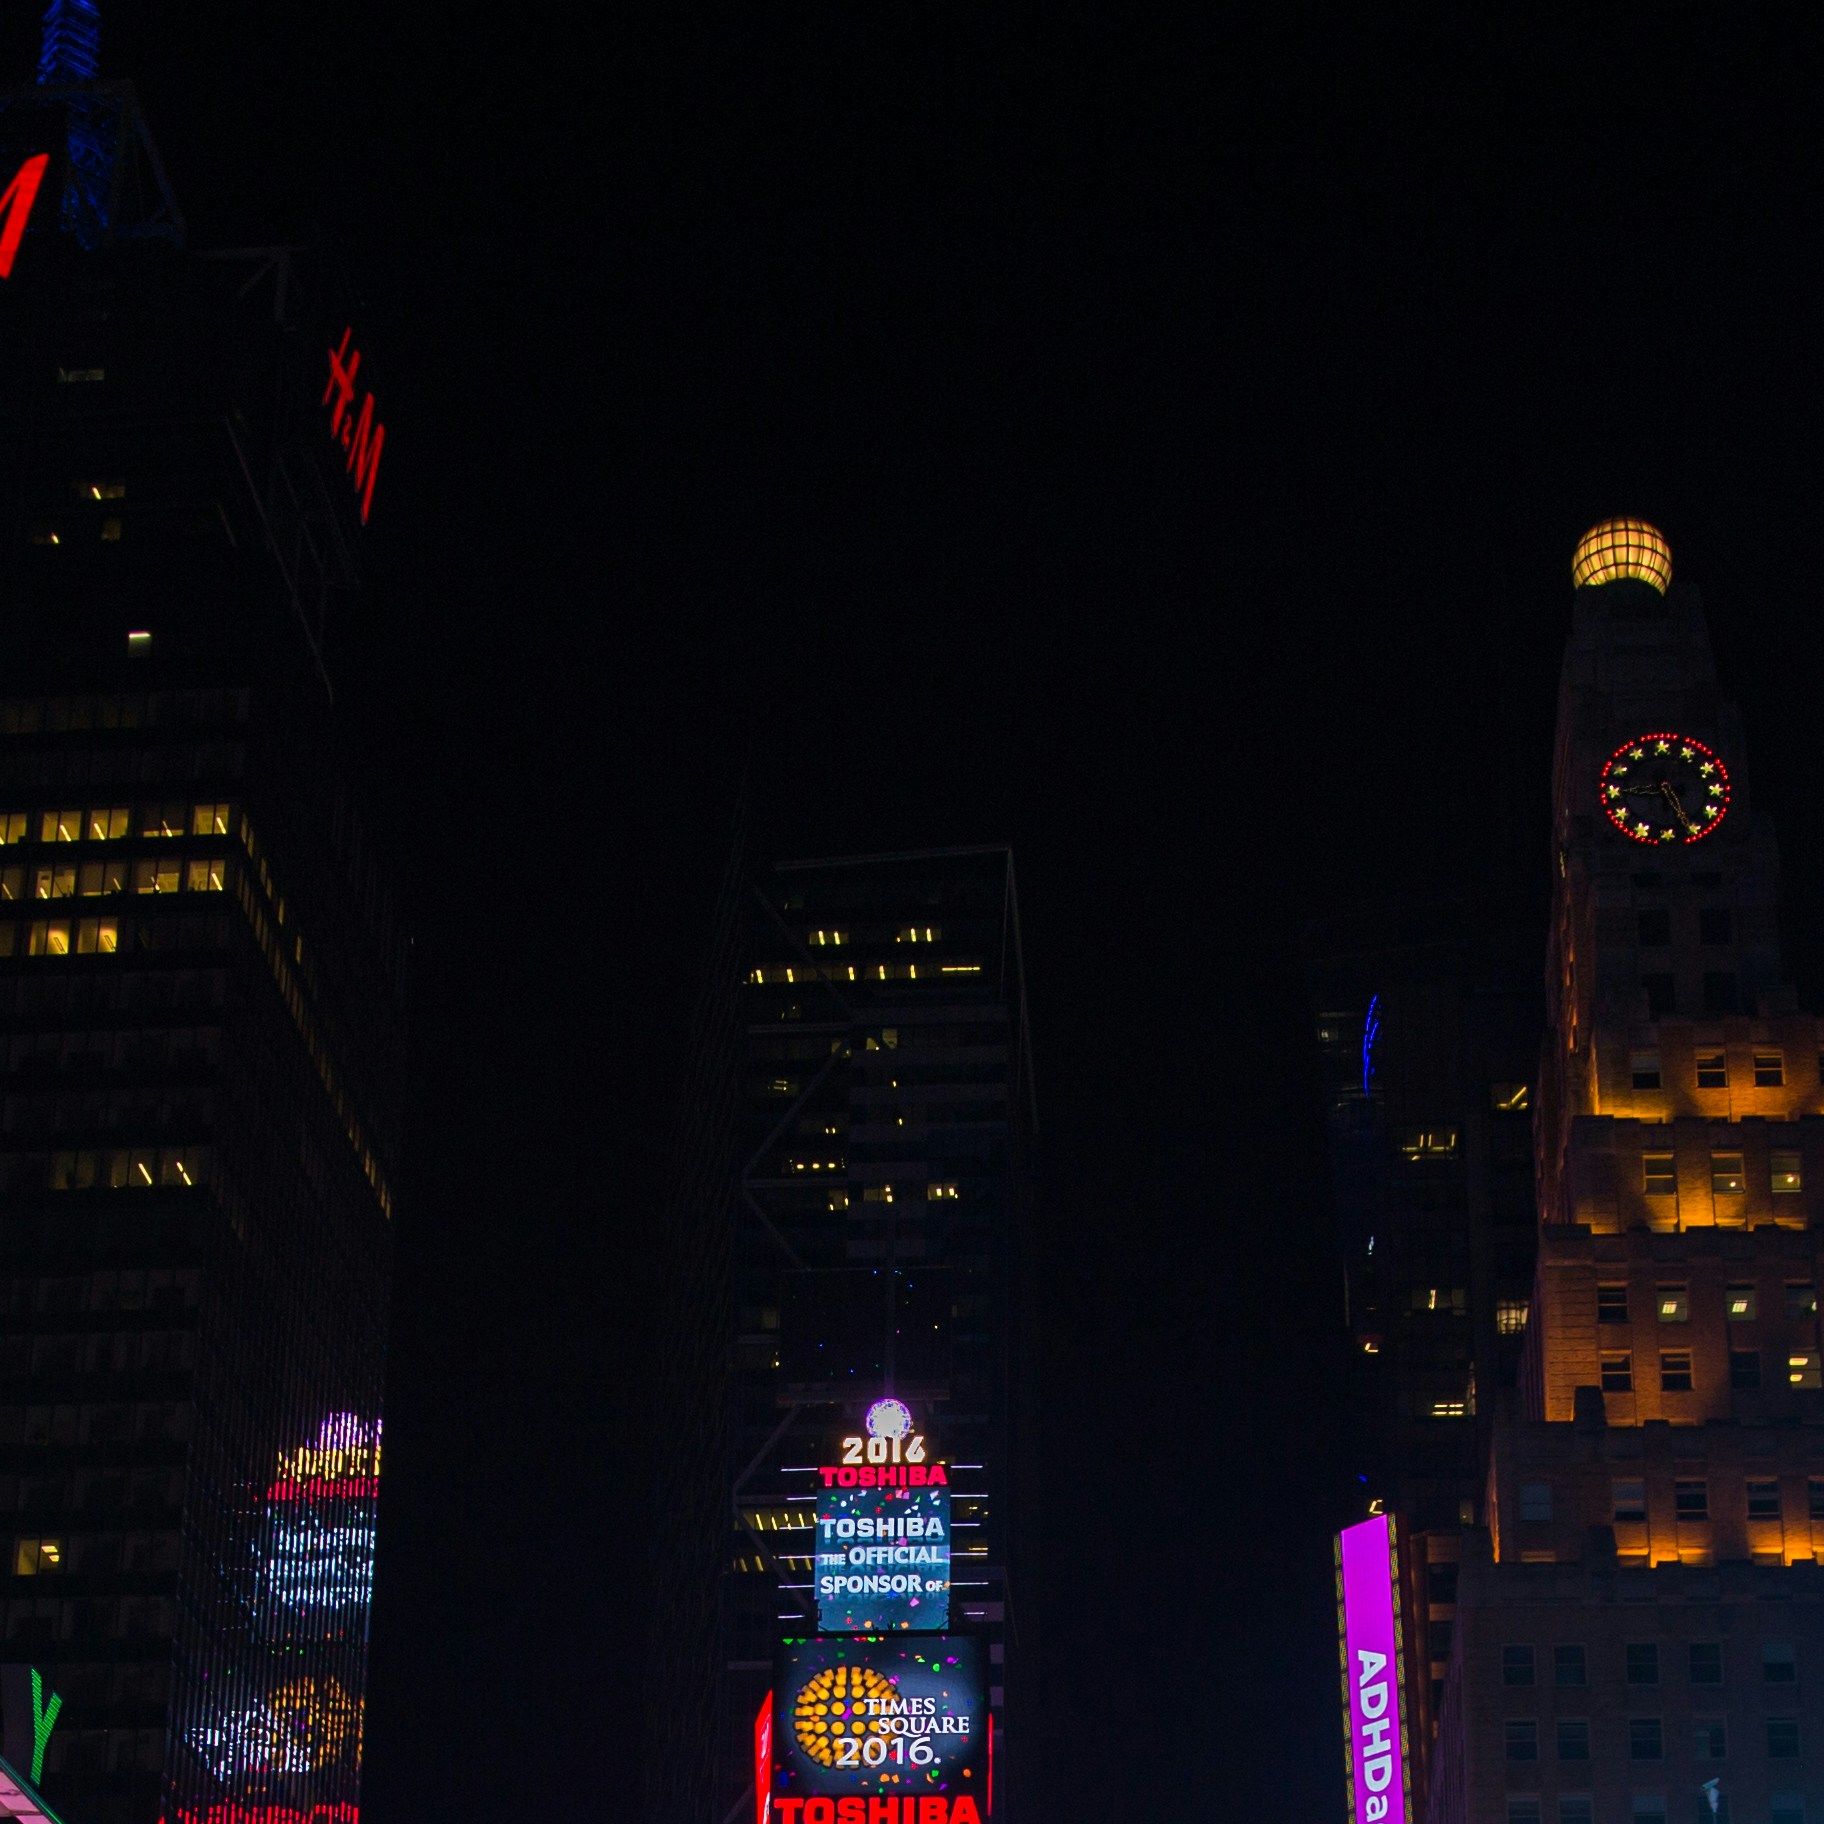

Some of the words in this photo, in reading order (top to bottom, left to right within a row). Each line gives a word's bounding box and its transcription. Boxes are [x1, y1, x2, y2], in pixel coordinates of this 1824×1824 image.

[323, 326, 385, 526] H&M
[842, 1435, 926, 1465] 2016
[819, 1465, 947, 1488] TOSHIBA
[820, 1517, 945, 1540] TOSHIBA
[821, 1553, 846, 1566] THE
[848, 1545, 943, 1566] OFFICIAL
[820, 1574, 923, 1595] SPONSOR
[925, 1580, 944, 1594] OF
[864, 1697, 936, 1717] TIMES
[878, 1717, 970, 1737] SQUARE
